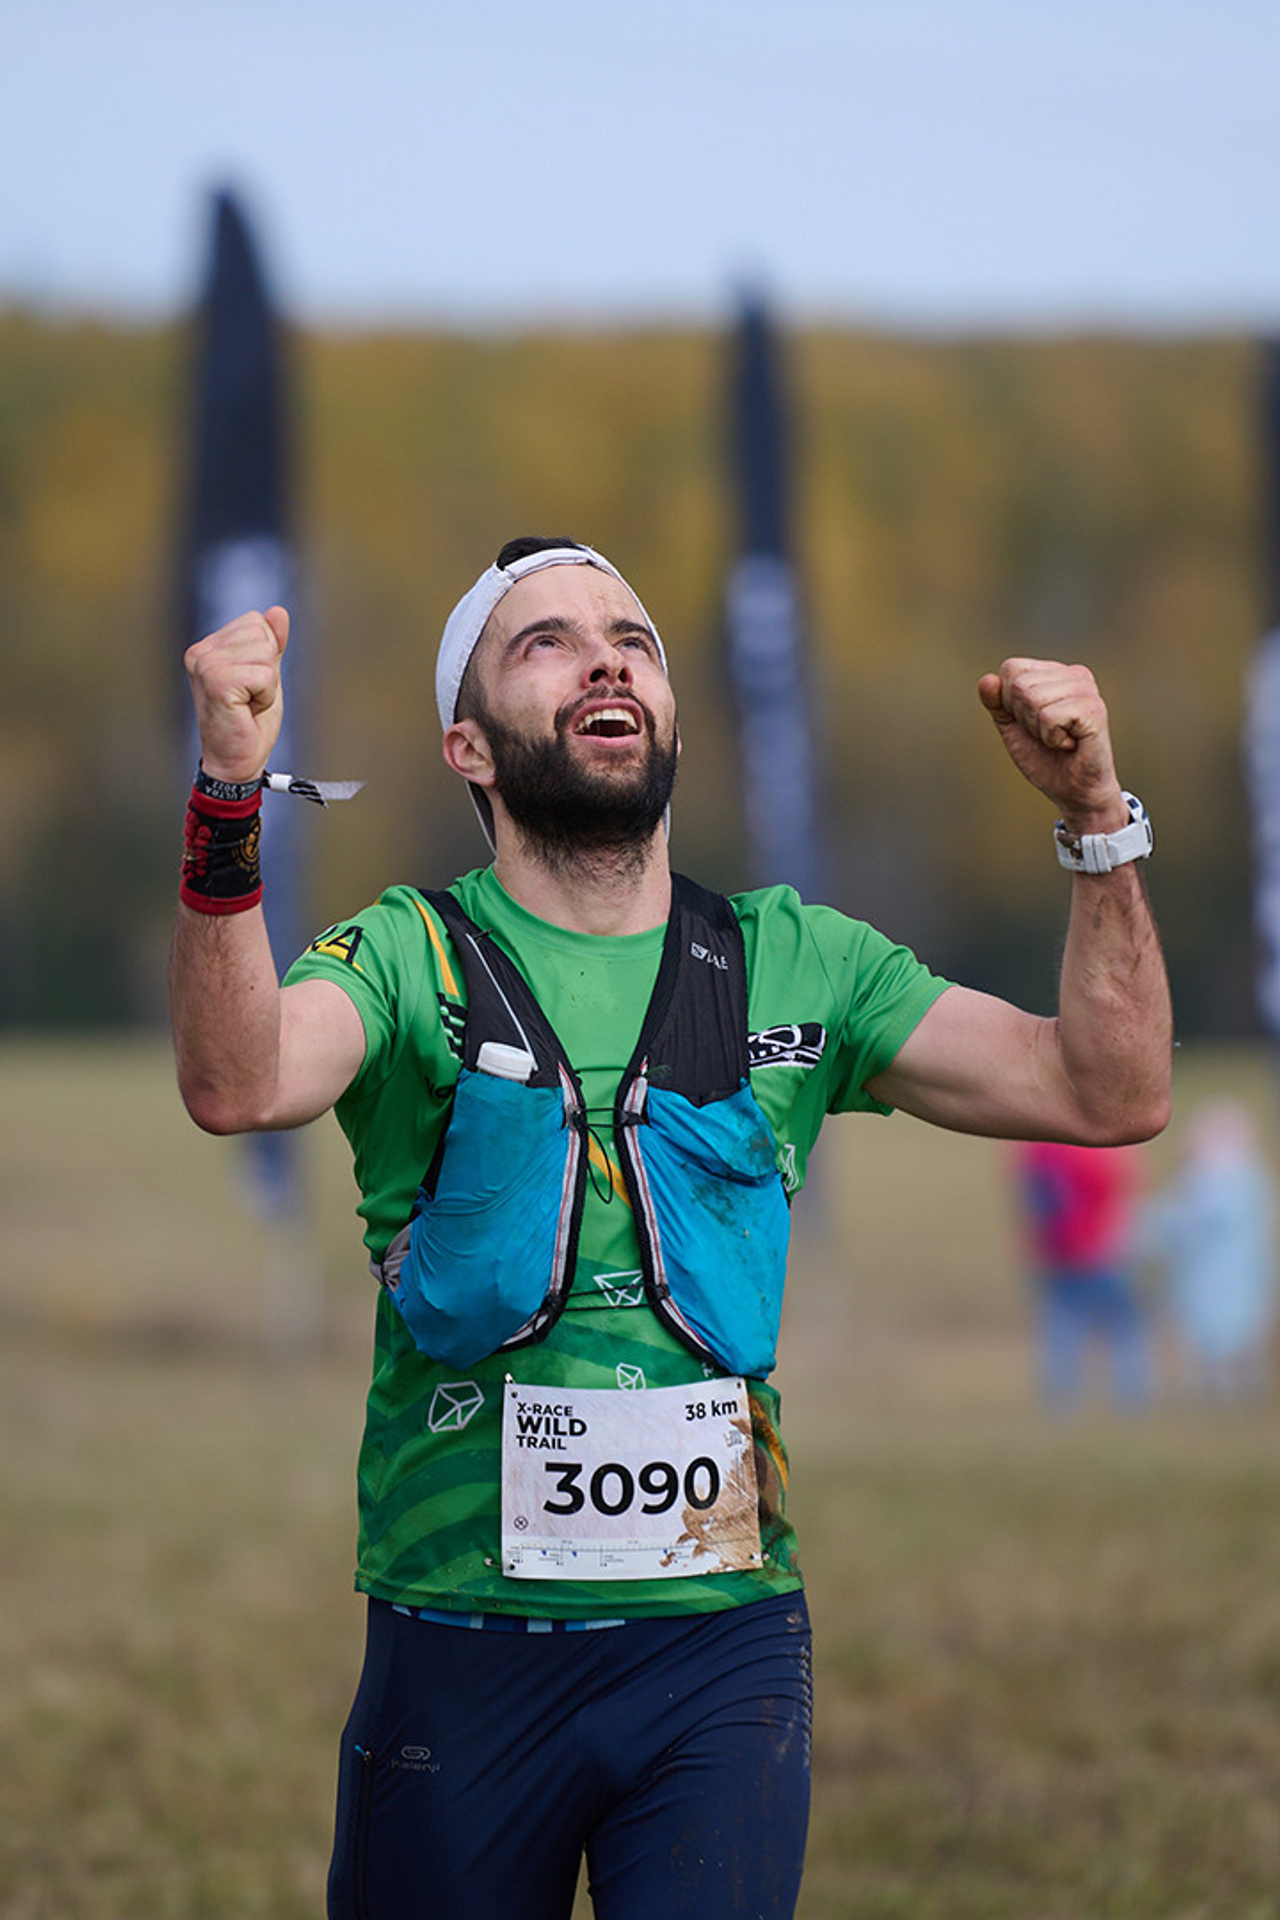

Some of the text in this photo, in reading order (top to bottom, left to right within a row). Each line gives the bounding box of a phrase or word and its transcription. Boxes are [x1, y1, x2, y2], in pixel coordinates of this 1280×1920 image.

[516, 1402, 574, 1417] X-RACE
[685, 1398, 738, 1421] 38 km
[516, 1416, 588, 1437] WILD
[516, 1435, 567, 1450] TRAIL
[542, 1456, 721, 1516] 3090
